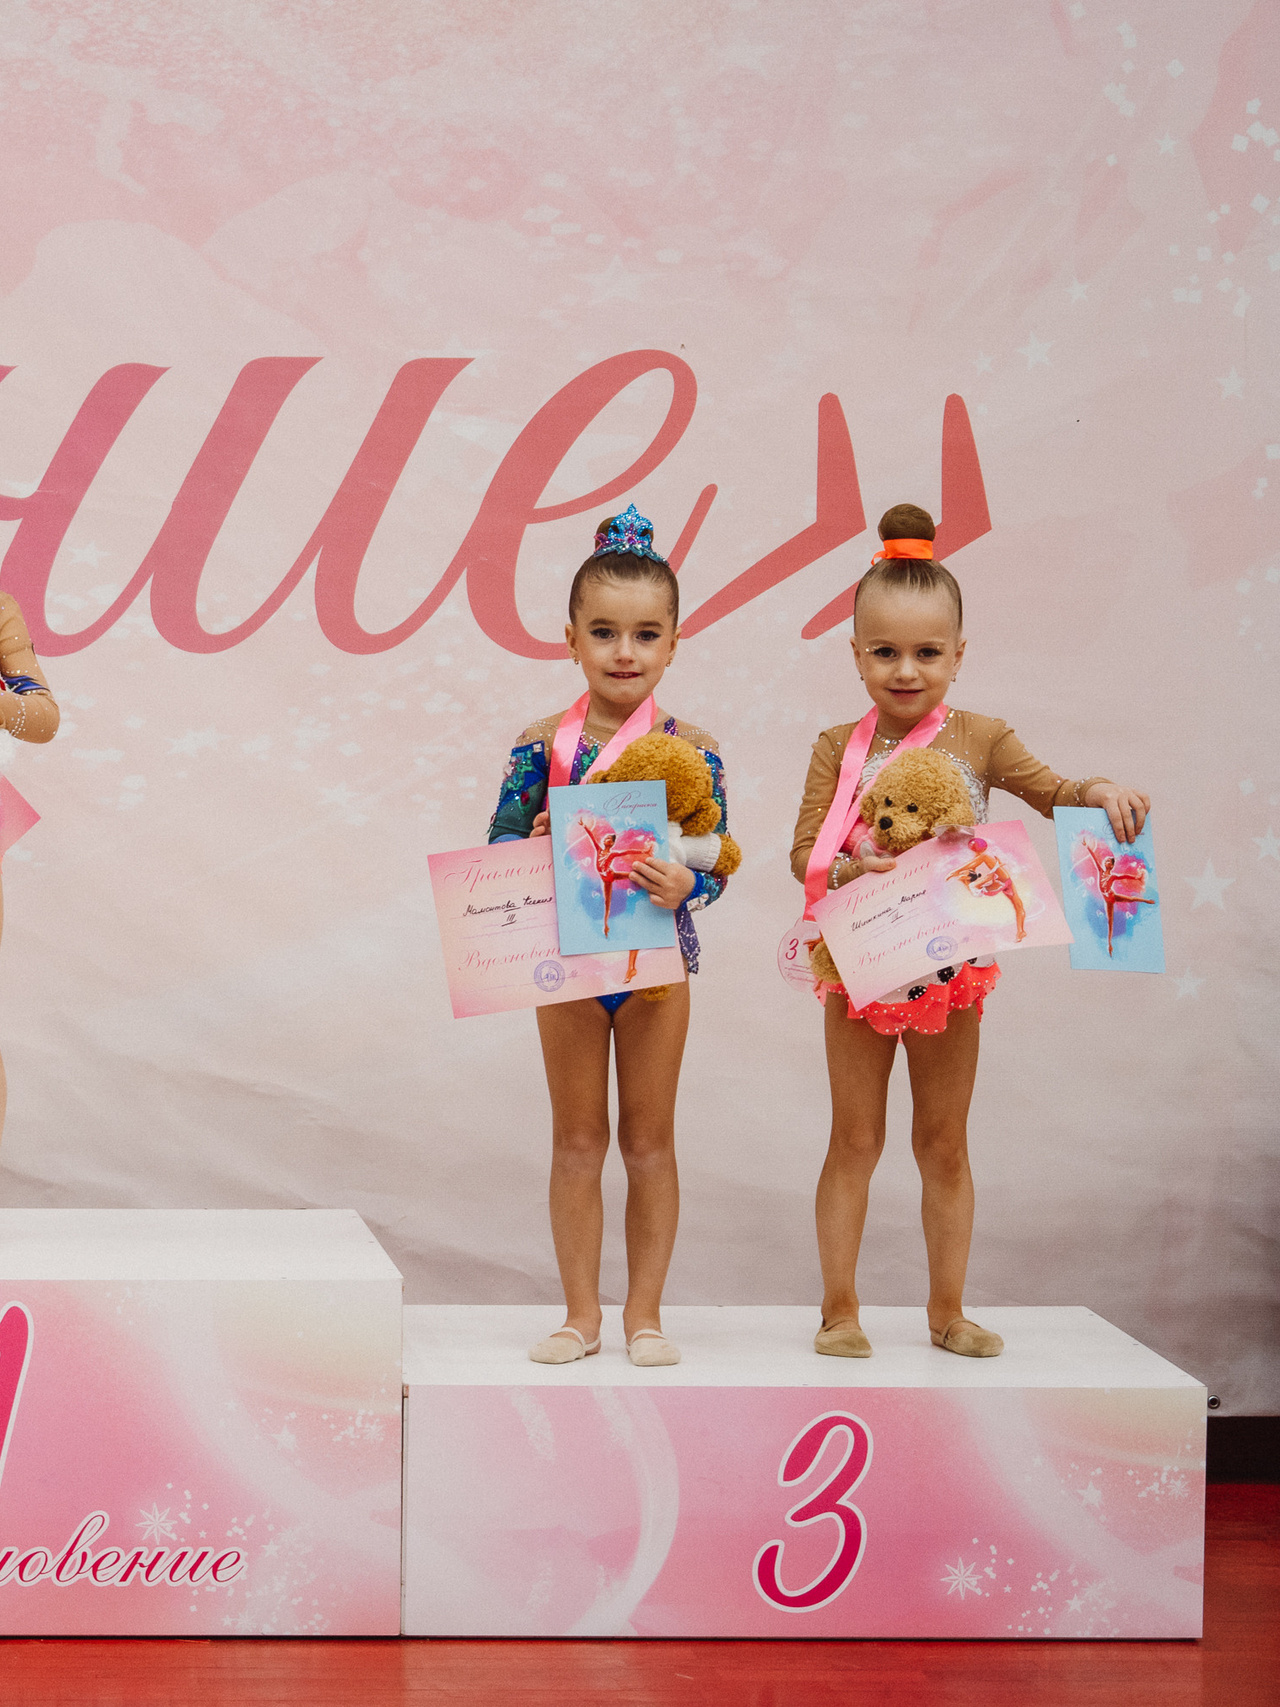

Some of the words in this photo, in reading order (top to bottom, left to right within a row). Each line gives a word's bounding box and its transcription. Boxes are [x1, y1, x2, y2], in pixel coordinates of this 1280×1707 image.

[458, 942, 560, 976] Вдохновен
[785, 938, 799, 960] 3
[752, 1410, 874, 1613] 3
